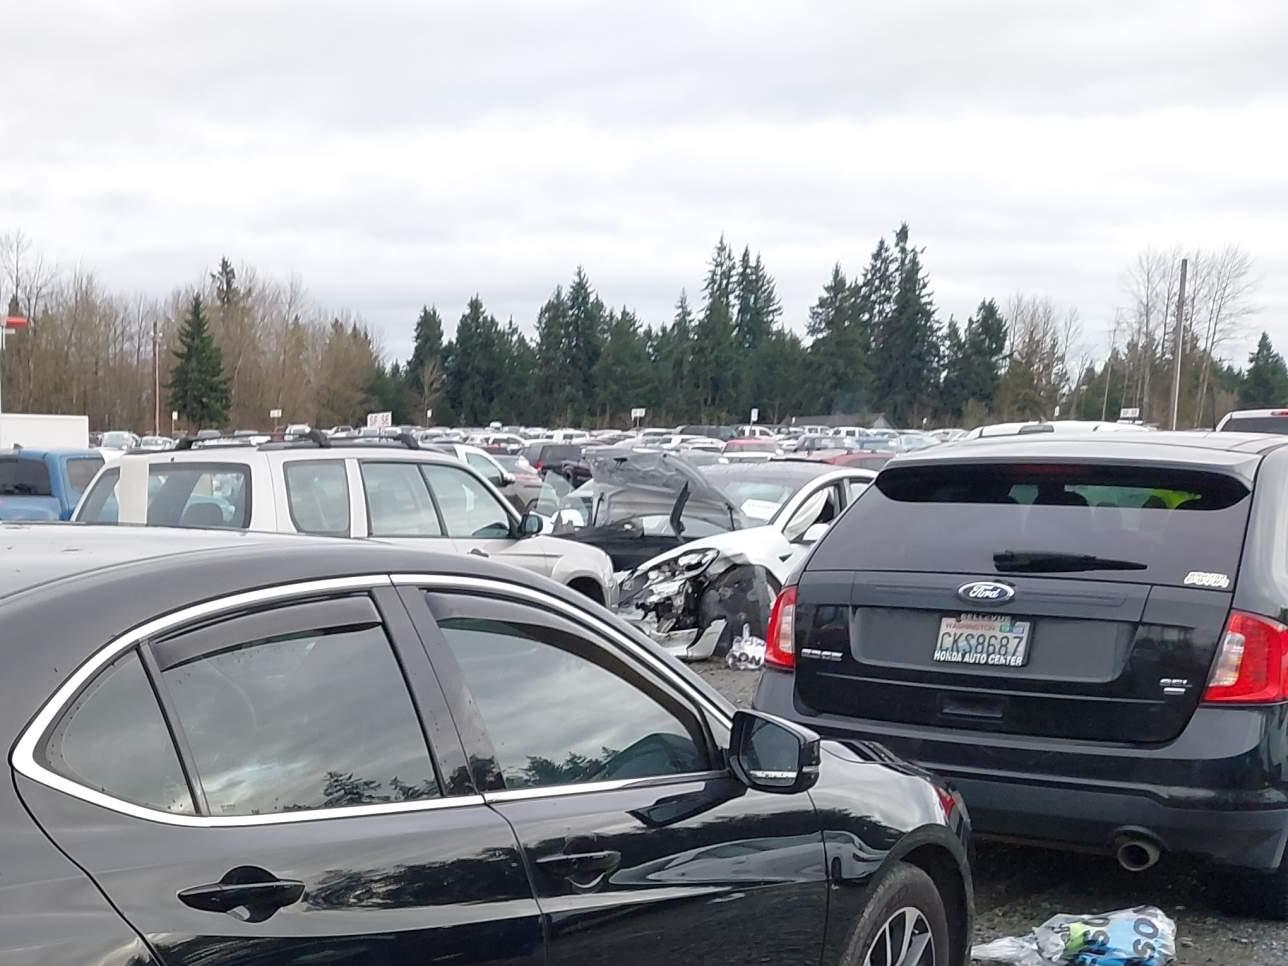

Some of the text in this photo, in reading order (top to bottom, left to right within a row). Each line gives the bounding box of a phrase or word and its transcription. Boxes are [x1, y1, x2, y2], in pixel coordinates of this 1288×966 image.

[968, 584, 1001, 599] Ford
[939, 631, 1024, 657] CKS8687
[933, 650, 1023, 667] HONDA AUTO CENTER
